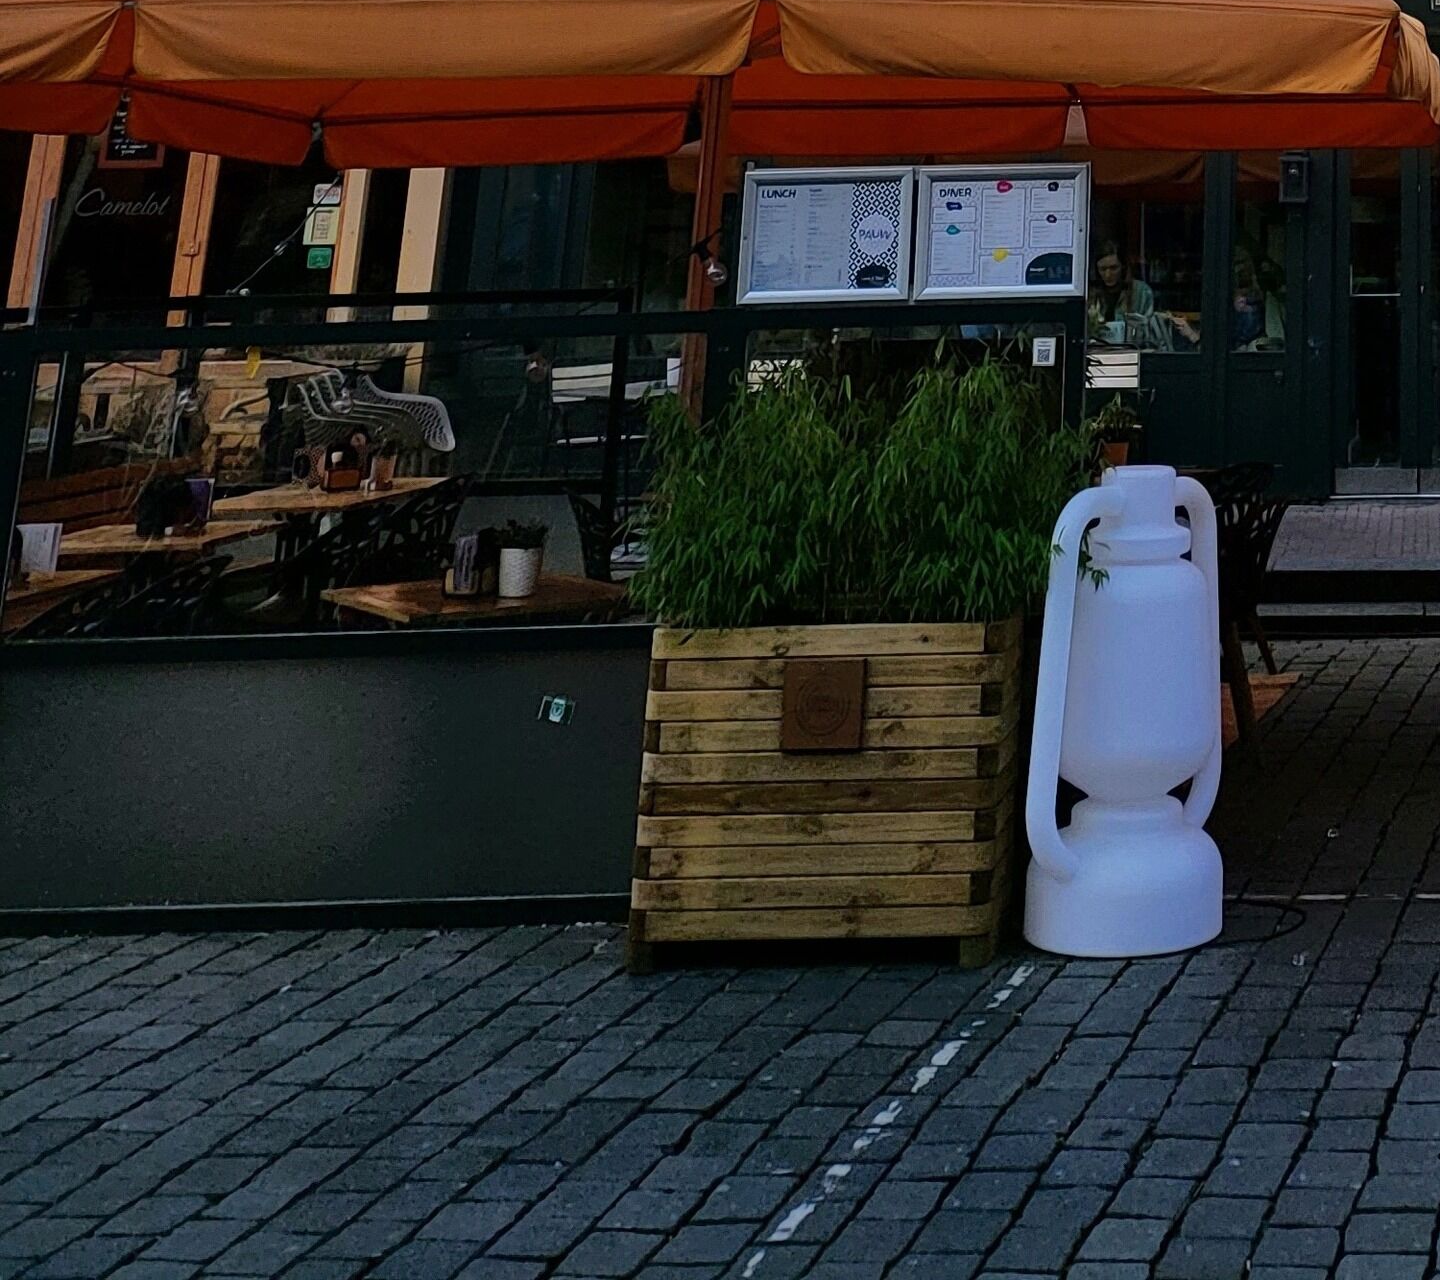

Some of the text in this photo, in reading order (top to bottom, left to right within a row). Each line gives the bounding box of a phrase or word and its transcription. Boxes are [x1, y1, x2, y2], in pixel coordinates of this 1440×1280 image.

[761, 188, 797, 200] LUNCH
[939, 187, 972, 199] DINER
[75, 188, 171, 217] Camelot
[858, 228, 892, 242] PAUW
